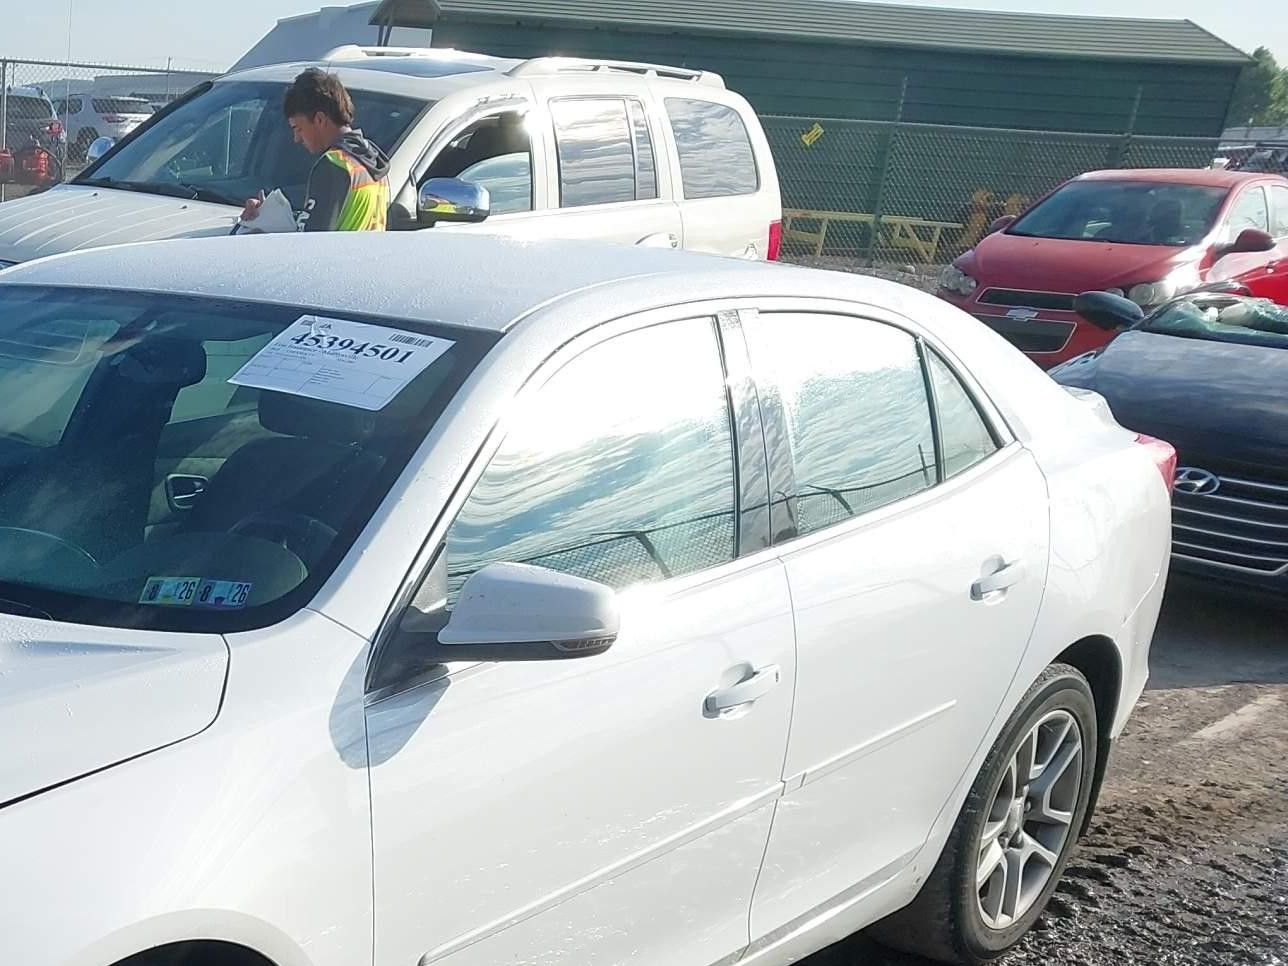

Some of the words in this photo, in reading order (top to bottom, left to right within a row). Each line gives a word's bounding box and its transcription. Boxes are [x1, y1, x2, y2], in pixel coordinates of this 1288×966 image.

[290, 331, 416, 364] 45394501
[178, 581, 196, 600] 26
[232, 583, 250, 603] 26
